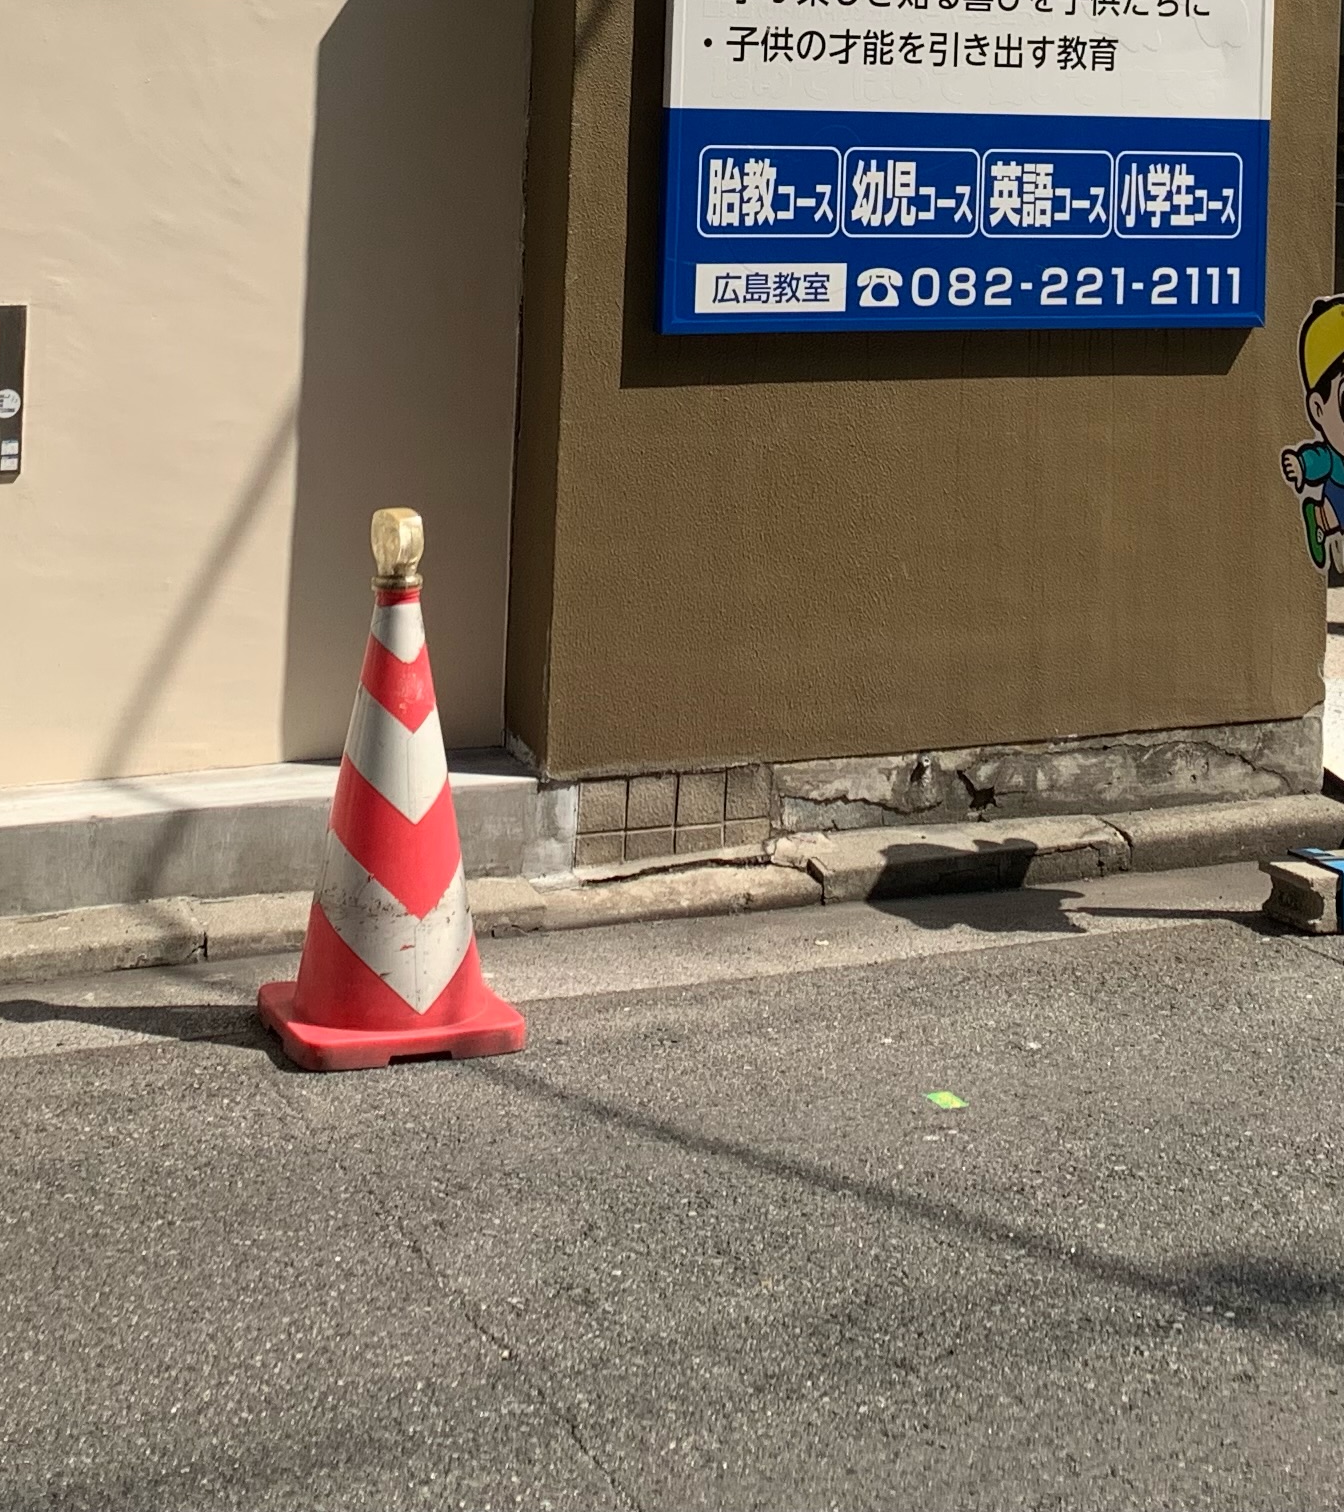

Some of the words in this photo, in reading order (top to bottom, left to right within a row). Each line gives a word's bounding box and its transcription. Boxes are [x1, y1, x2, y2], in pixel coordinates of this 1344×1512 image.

[707, 159, 834, 228] 胎教コース
[852, 160, 973, 227] 幼児コース
[989, 161, 1107, 228] 英語コース
[1121, 163, 1236, 229] 小学生コース
[712, 271, 830, 304] 広島教室
[911, 266, 1240, 307] 082-221-2111
